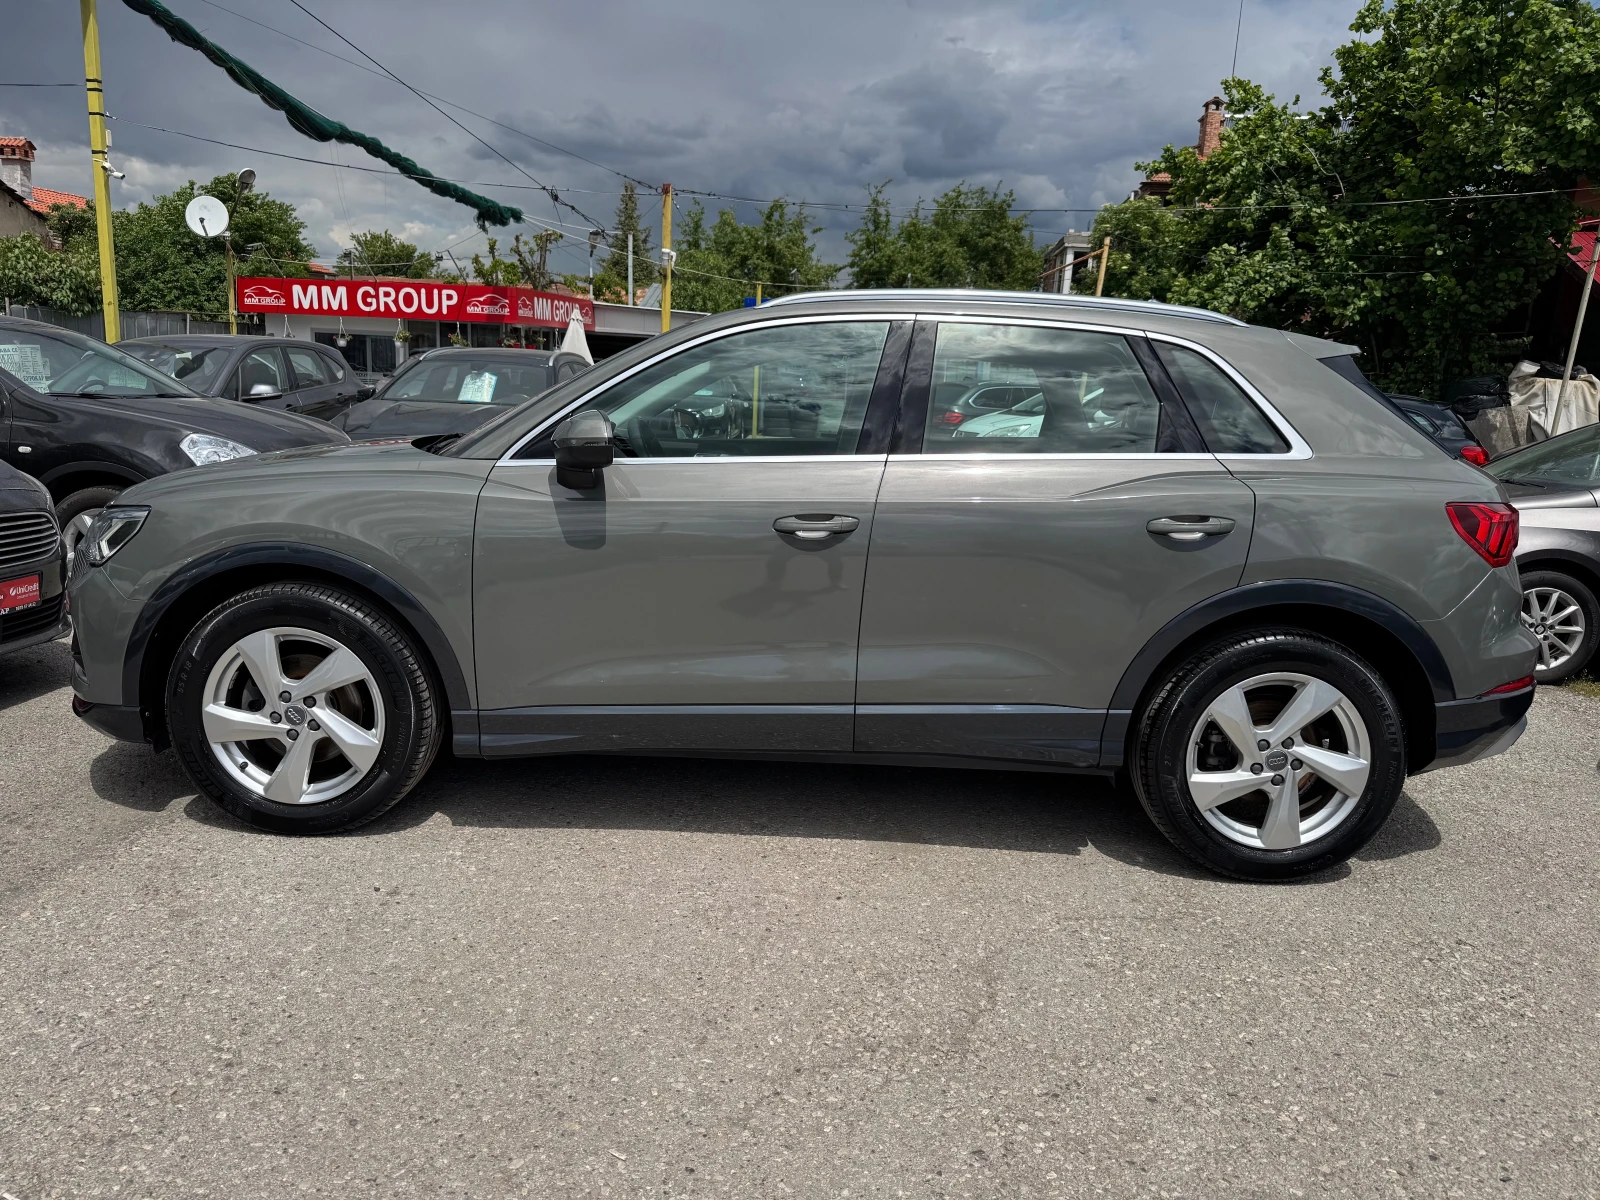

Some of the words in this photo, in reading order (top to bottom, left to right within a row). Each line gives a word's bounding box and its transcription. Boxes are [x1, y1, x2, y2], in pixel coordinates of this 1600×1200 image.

[292, 284, 348, 311] MM
[356, 286, 458, 315] GROUP
[533, 296, 552, 321] MM
[1357, 675, 1399, 751] MICHELIN
